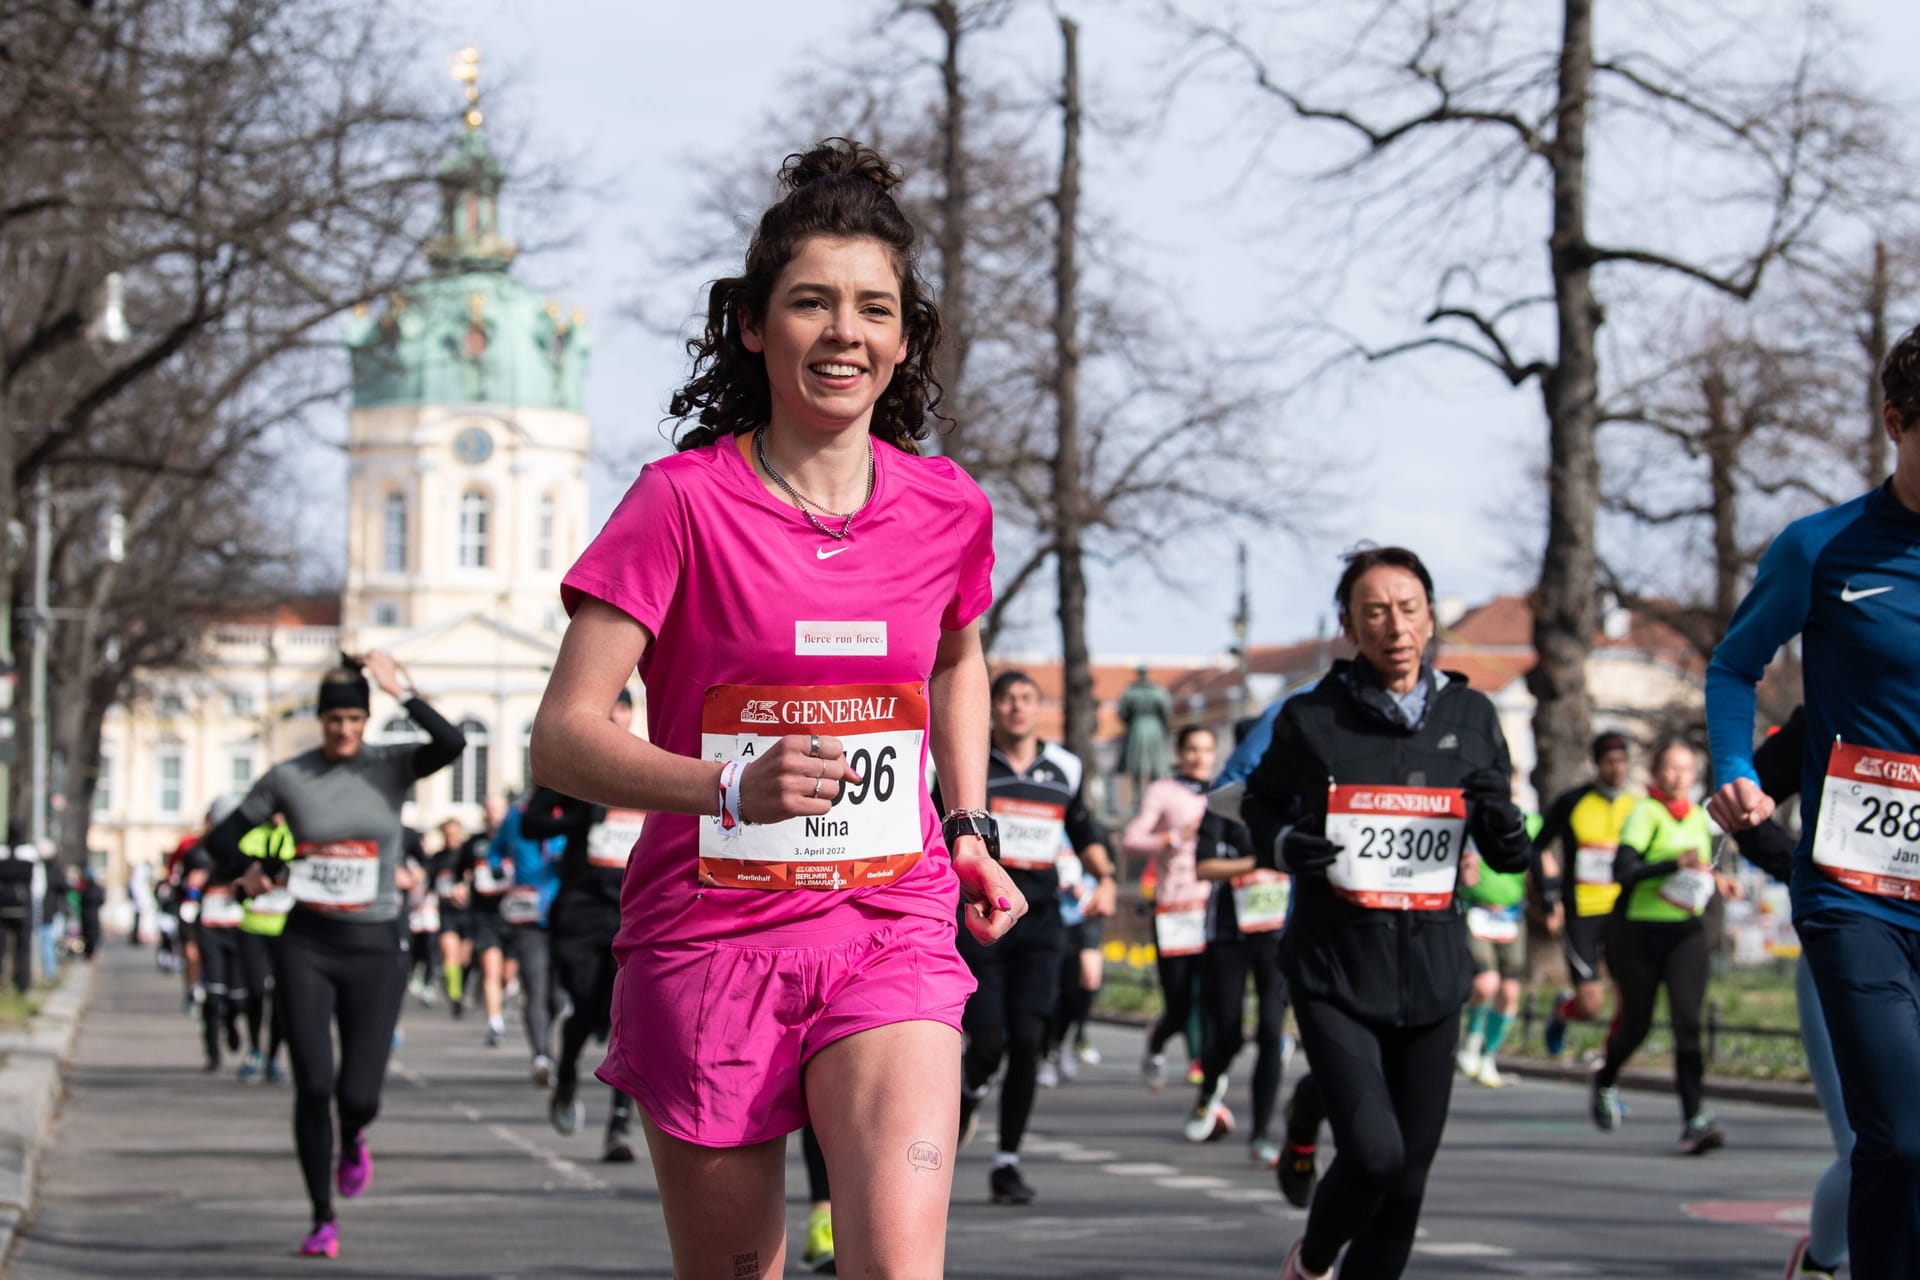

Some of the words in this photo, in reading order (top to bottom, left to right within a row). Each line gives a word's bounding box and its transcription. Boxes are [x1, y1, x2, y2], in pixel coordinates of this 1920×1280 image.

[804, 633, 832, 644] fierce
[835, 635, 852, 644] run
[856, 633, 884, 644] force.
[781, 696, 898, 725] GENERALI
[742, 742, 755, 756] A
[1374, 792, 1451, 813] GENERALI
[1855, 796, 1920, 842] 288
[805, 816, 849, 838] Nina
[794, 847, 802, 856] 3.
[804, 847, 825, 857] April
[826, 846, 846, 855] 2022
[1358, 826, 1452, 862] 23308
[1892, 847, 1919, 864] Jan
[804, 865, 833, 873] GENERALI
[737, 872, 771, 883] #berlinhalf
[795, 879, 848, 887] HALBMARATON
